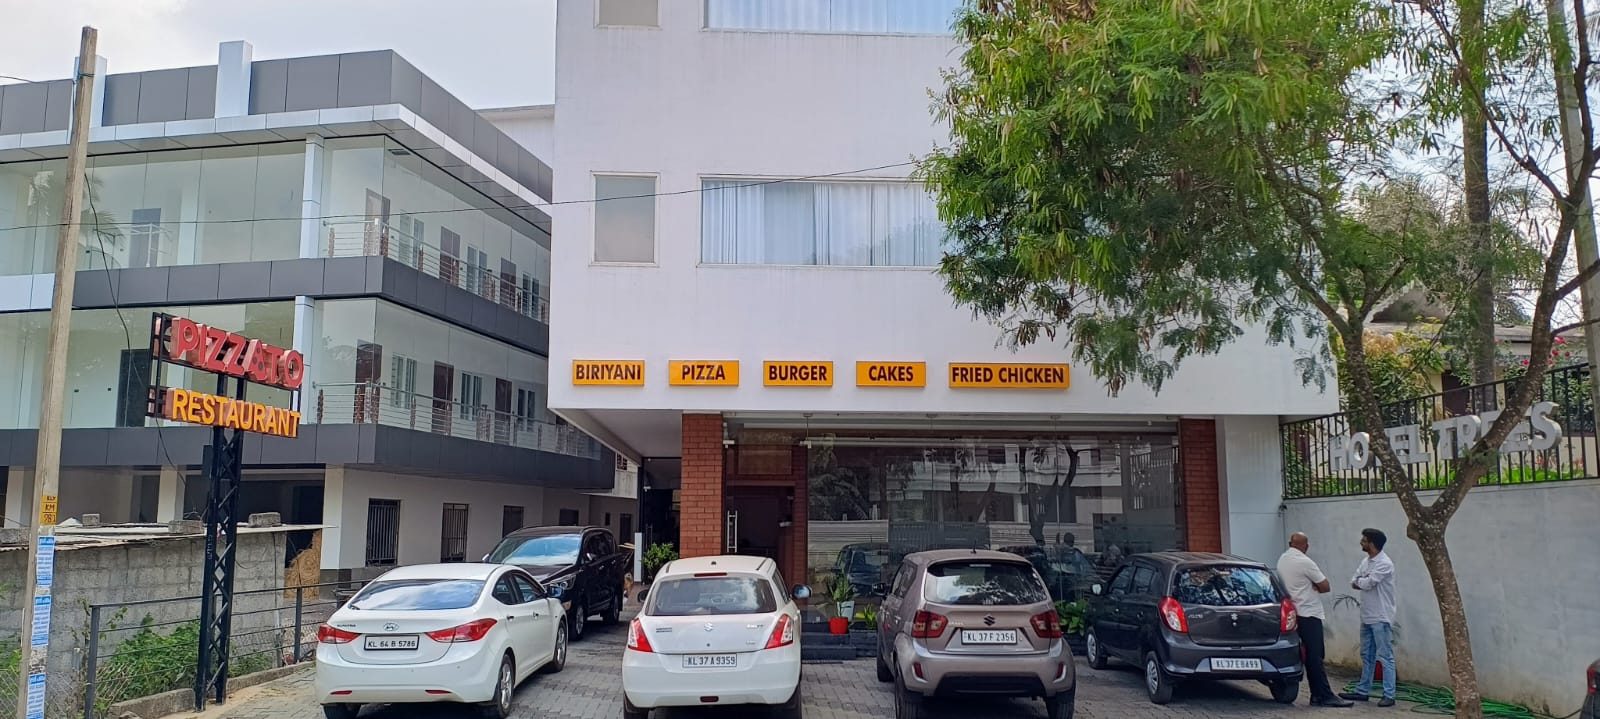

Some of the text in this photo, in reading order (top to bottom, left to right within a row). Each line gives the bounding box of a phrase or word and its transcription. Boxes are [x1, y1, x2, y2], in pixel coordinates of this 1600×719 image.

[171, 317, 304, 388] PIZZATO
[575, 364, 641, 380] BIRIYANI
[681, 364, 726, 381] PIZZA
[768, 365, 827, 382] BURGER
[868, 365, 914, 382] CAKES
[952, 367, 1064, 384] FRIED CHICKEN
[169, 388, 301, 437] RESTAURANT
[1329, 424, 1432, 472] HOEL
[367, 640, 378, 648] KL
[967, 633, 977, 641] KL
